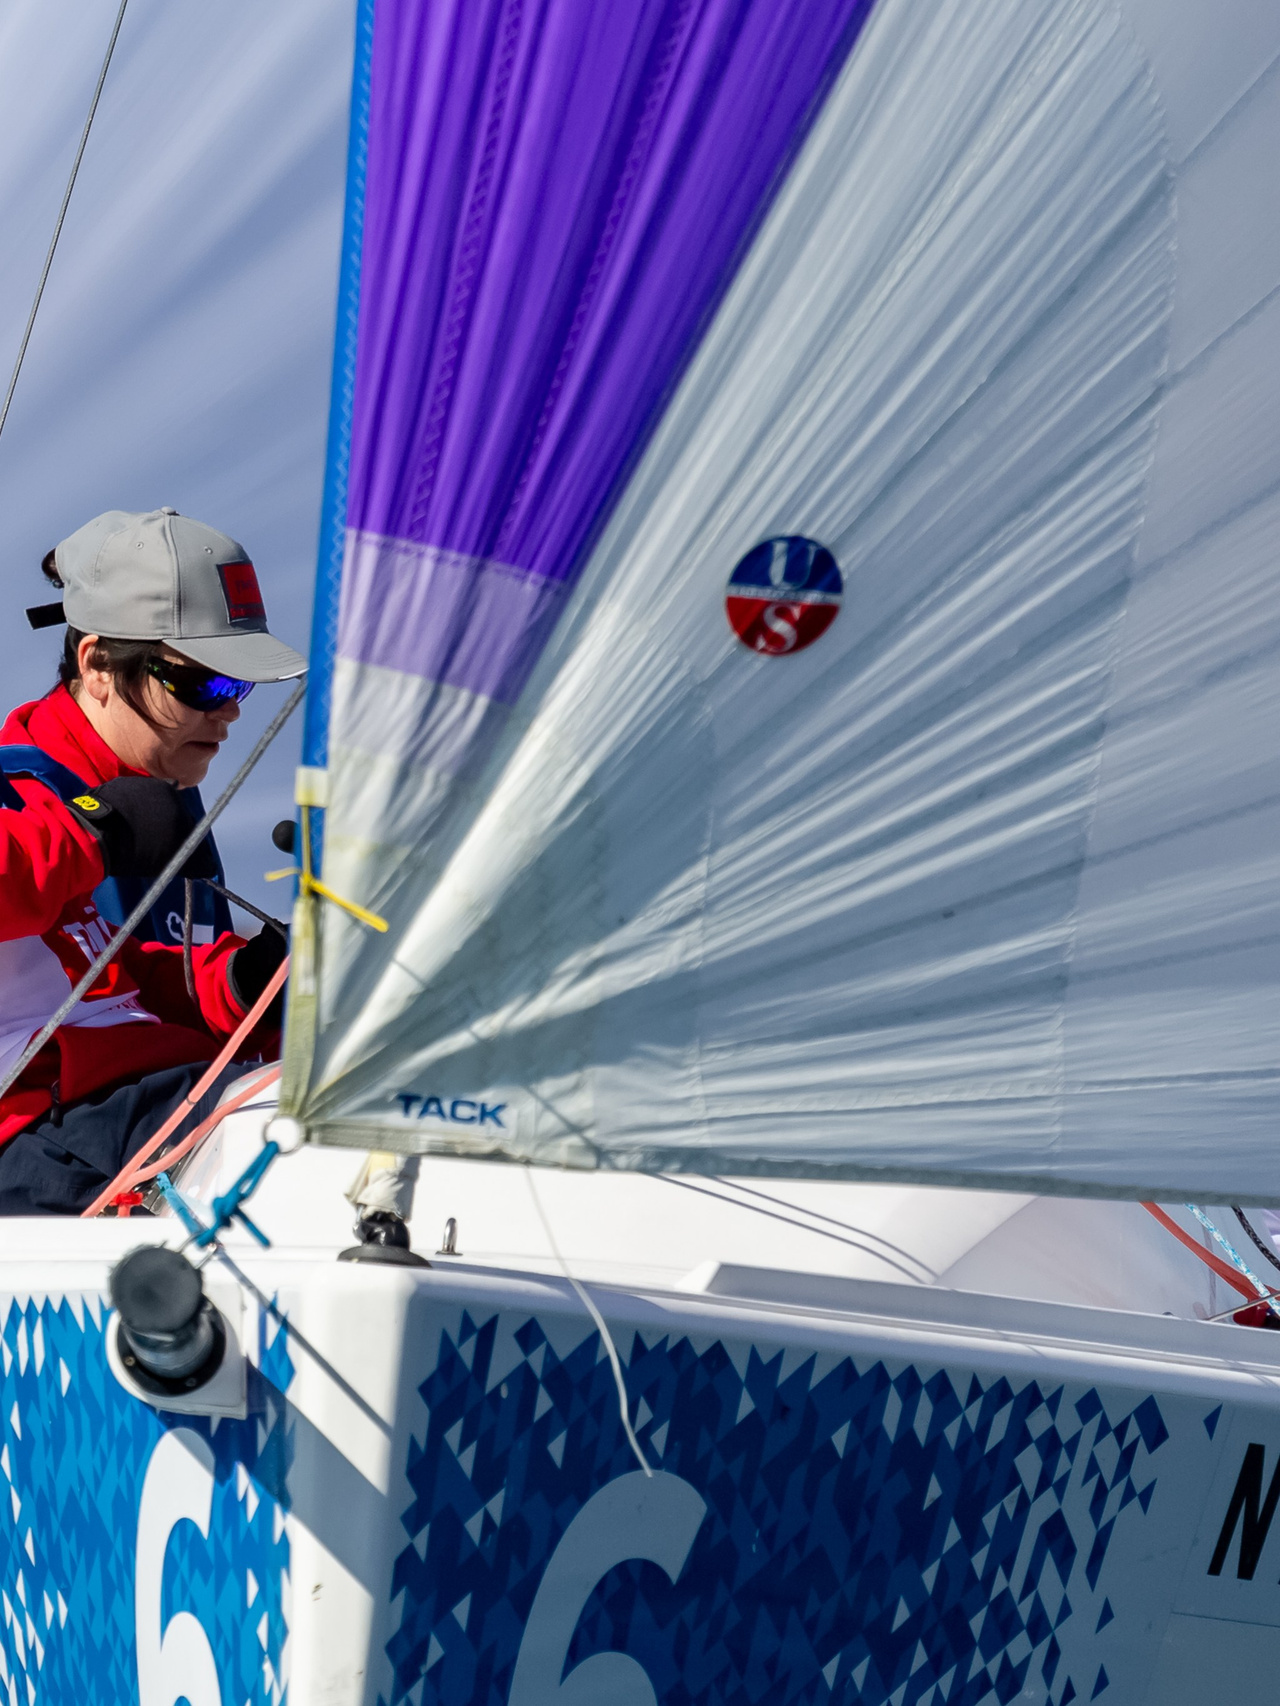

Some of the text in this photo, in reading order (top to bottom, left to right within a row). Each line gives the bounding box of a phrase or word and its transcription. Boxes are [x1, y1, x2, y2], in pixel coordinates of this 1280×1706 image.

[396, 1093, 508, 1128] TACK
[135, 1427, 222, 1706] 6
[1207, 1442, 1280, 1584] N
